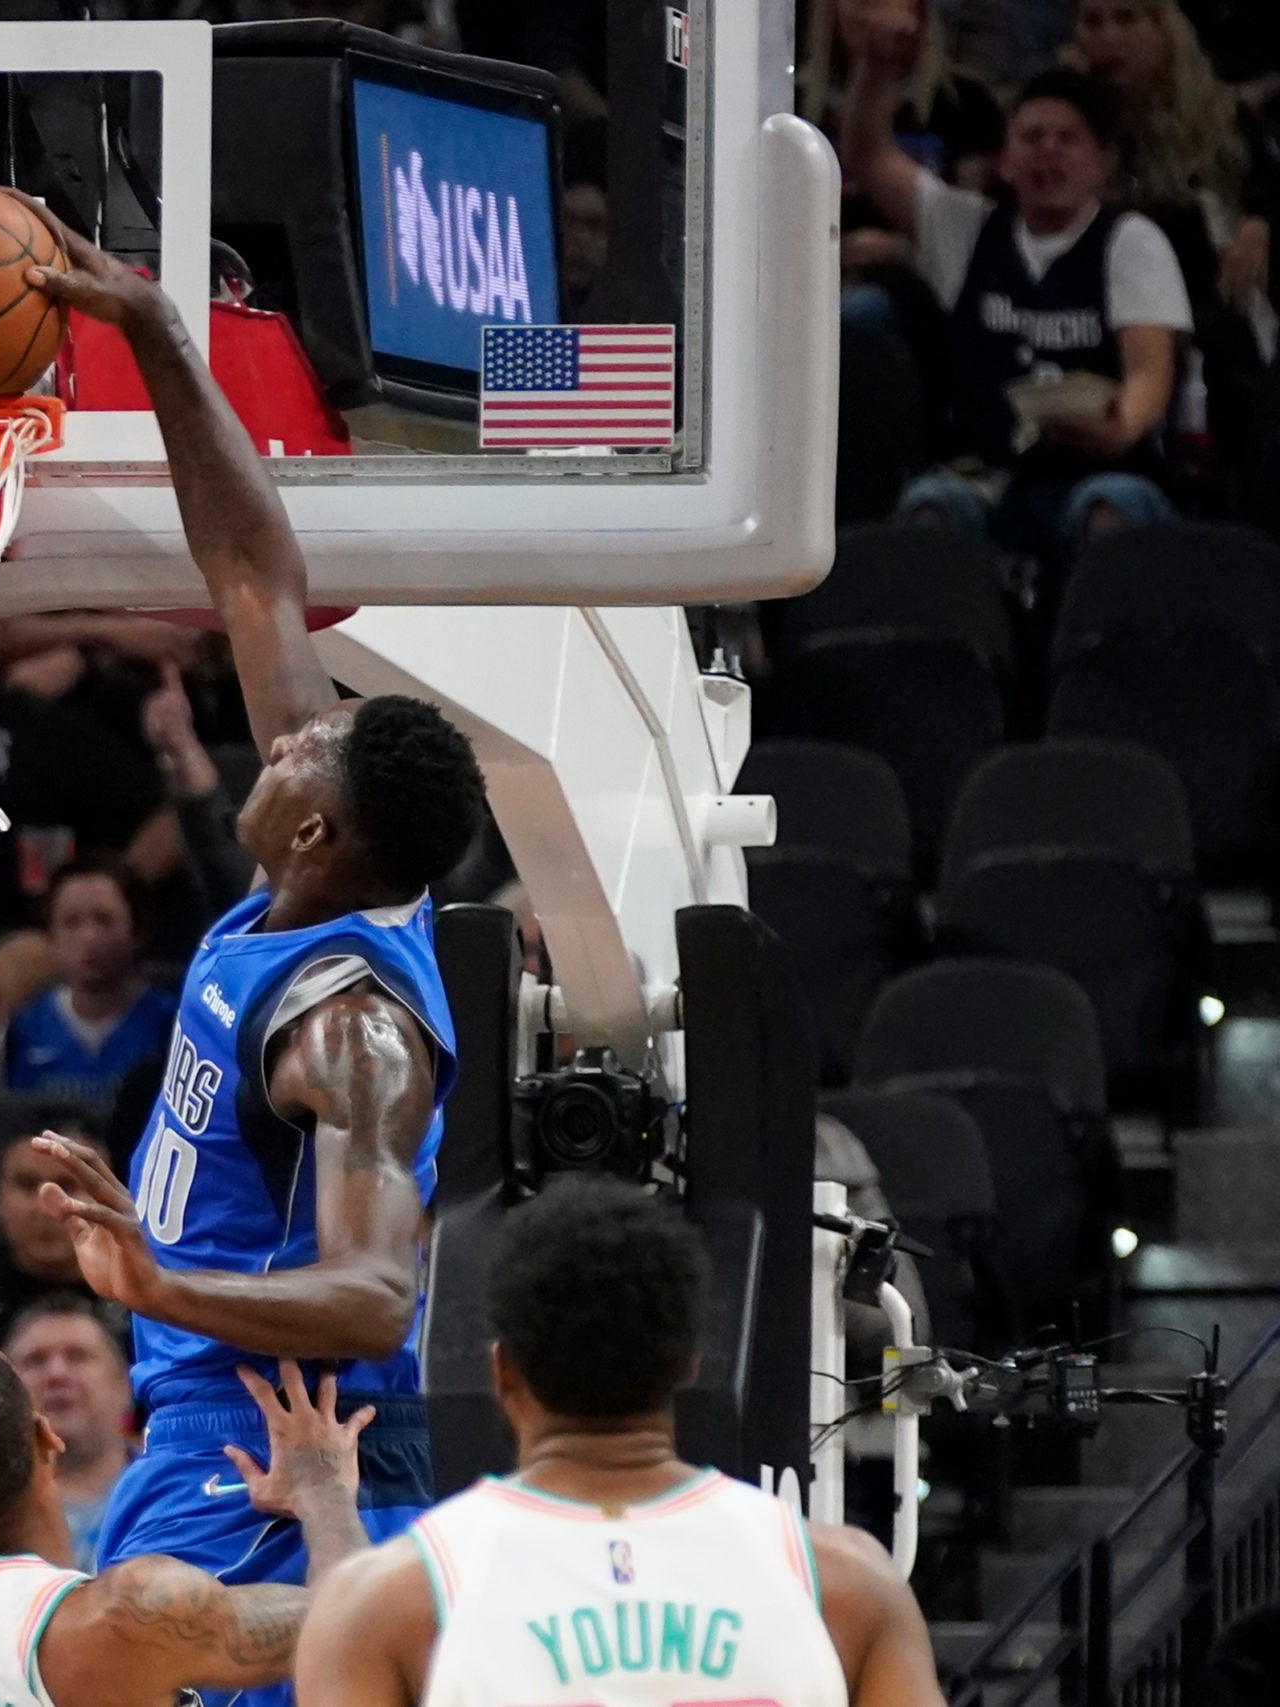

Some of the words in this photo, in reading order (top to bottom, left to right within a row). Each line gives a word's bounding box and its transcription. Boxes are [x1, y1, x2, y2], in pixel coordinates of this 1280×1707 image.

[439, 180, 533, 324] USAA
[201, 982, 236, 1030] chime
[527, 1600, 744, 1685] YOUNG
